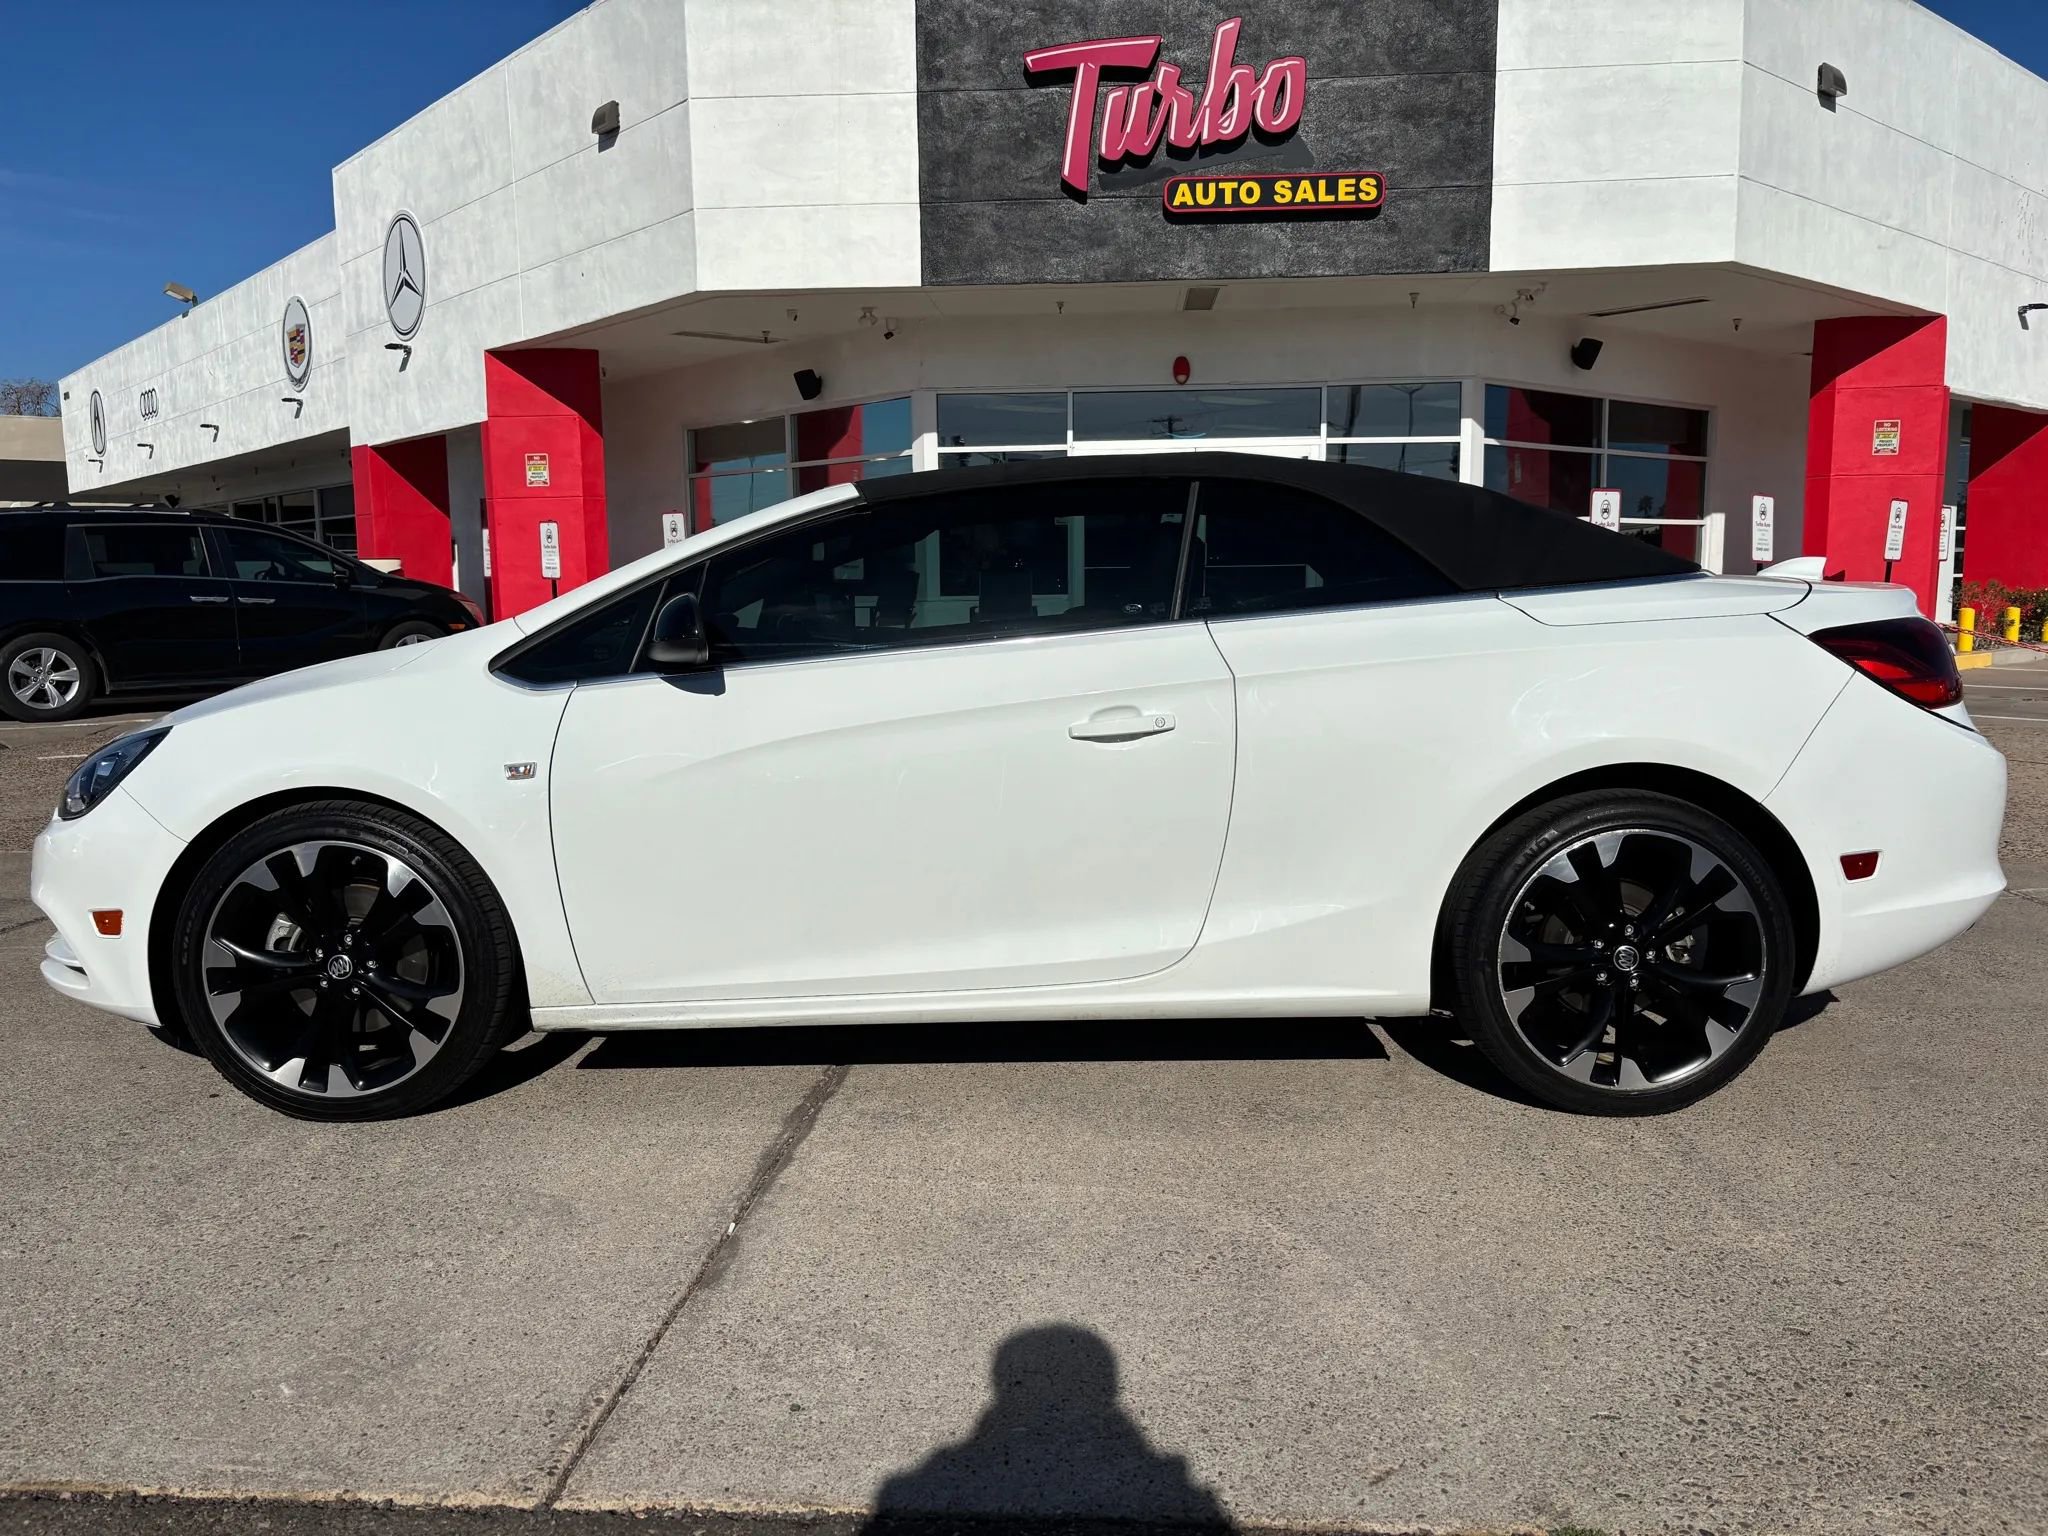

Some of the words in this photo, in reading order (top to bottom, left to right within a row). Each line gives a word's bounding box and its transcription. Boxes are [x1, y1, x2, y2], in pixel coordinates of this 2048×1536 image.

[1023, 16, 1307, 192] Turbo
[1172, 180, 1262, 206] AUTO
[1273, 177, 1378, 203] SALES
